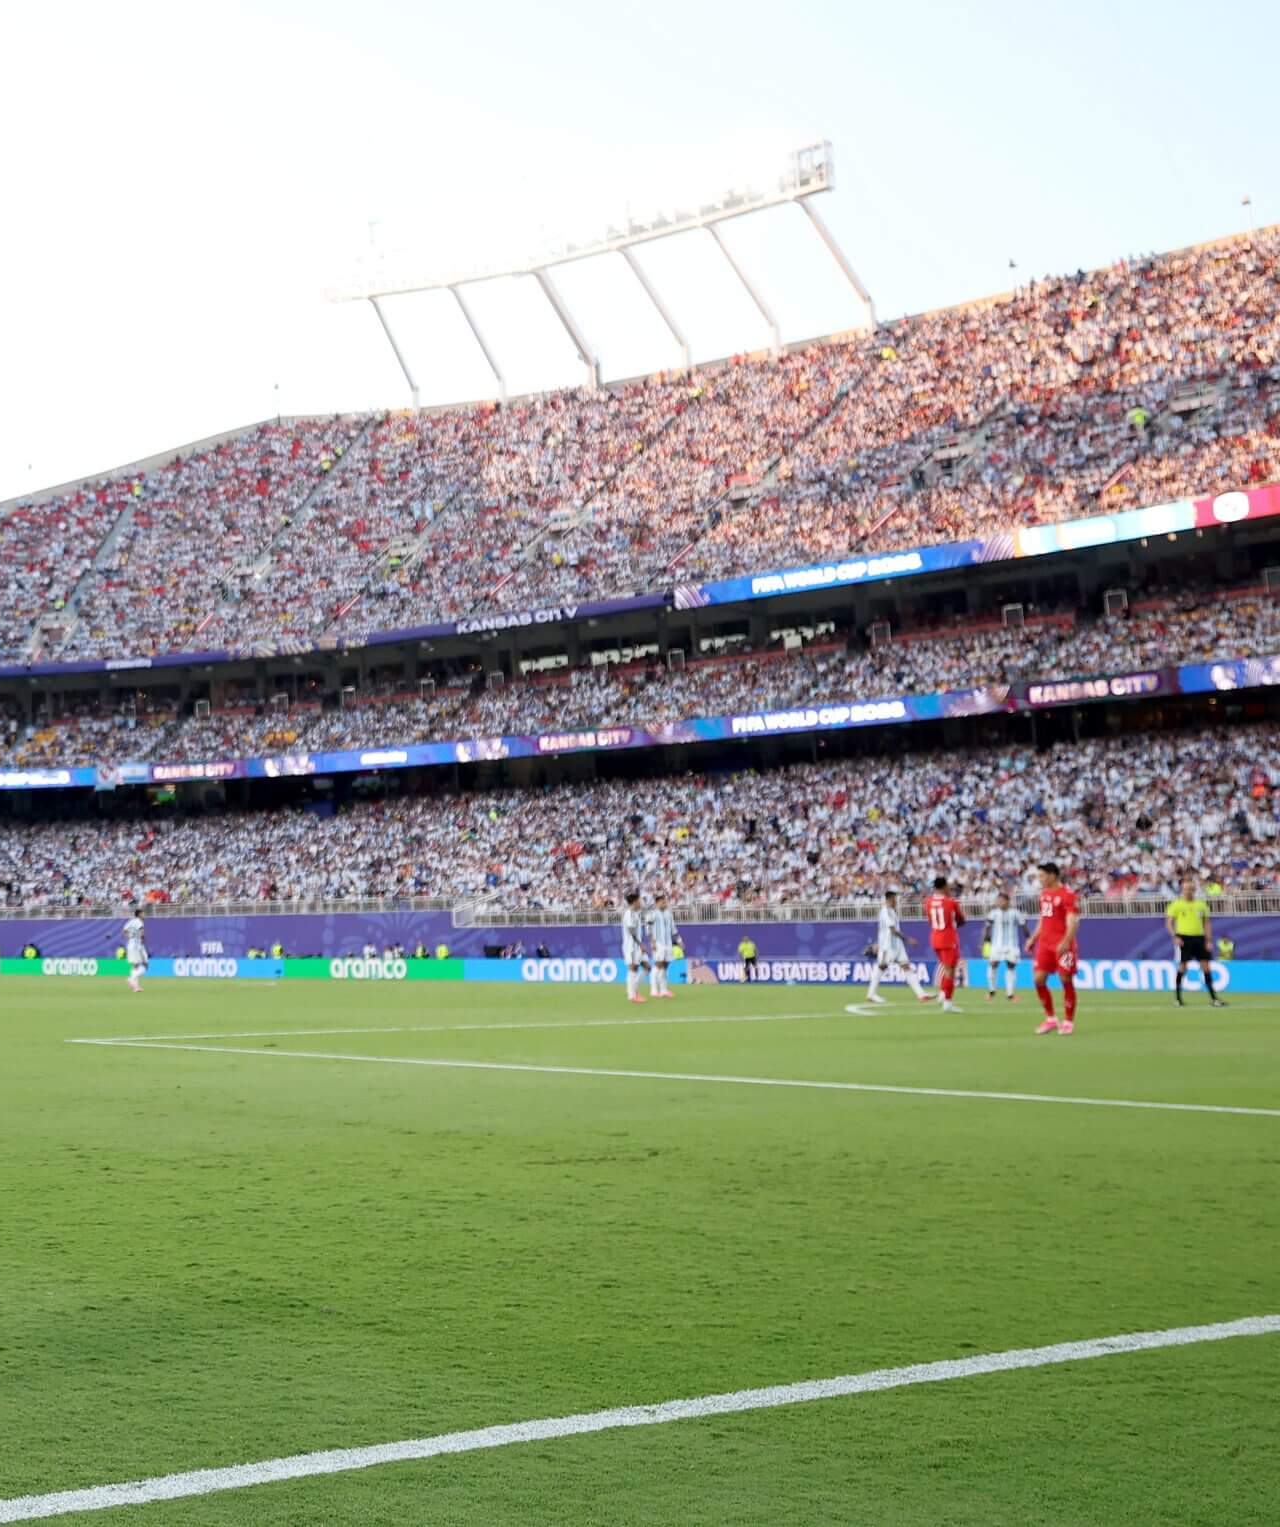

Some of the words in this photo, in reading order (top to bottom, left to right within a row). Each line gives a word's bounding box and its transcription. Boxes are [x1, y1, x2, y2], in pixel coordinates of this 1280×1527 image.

[456, 611, 533, 635] KANSAS
[1110, 673, 1158, 696] CITY
[930, 907, 945, 930] 11
[201, 941, 224, 954] FIFA
[42, 957, 98, 976] aramco
[173, 958, 238, 977] aramco
[330, 958, 407, 979] aramco
[522, 958, 617, 982] aramco
[772, 962, 828, 981] STATES
[829, 963, 851, 981] OF
[1073, 959, 1231, 991] aramco
